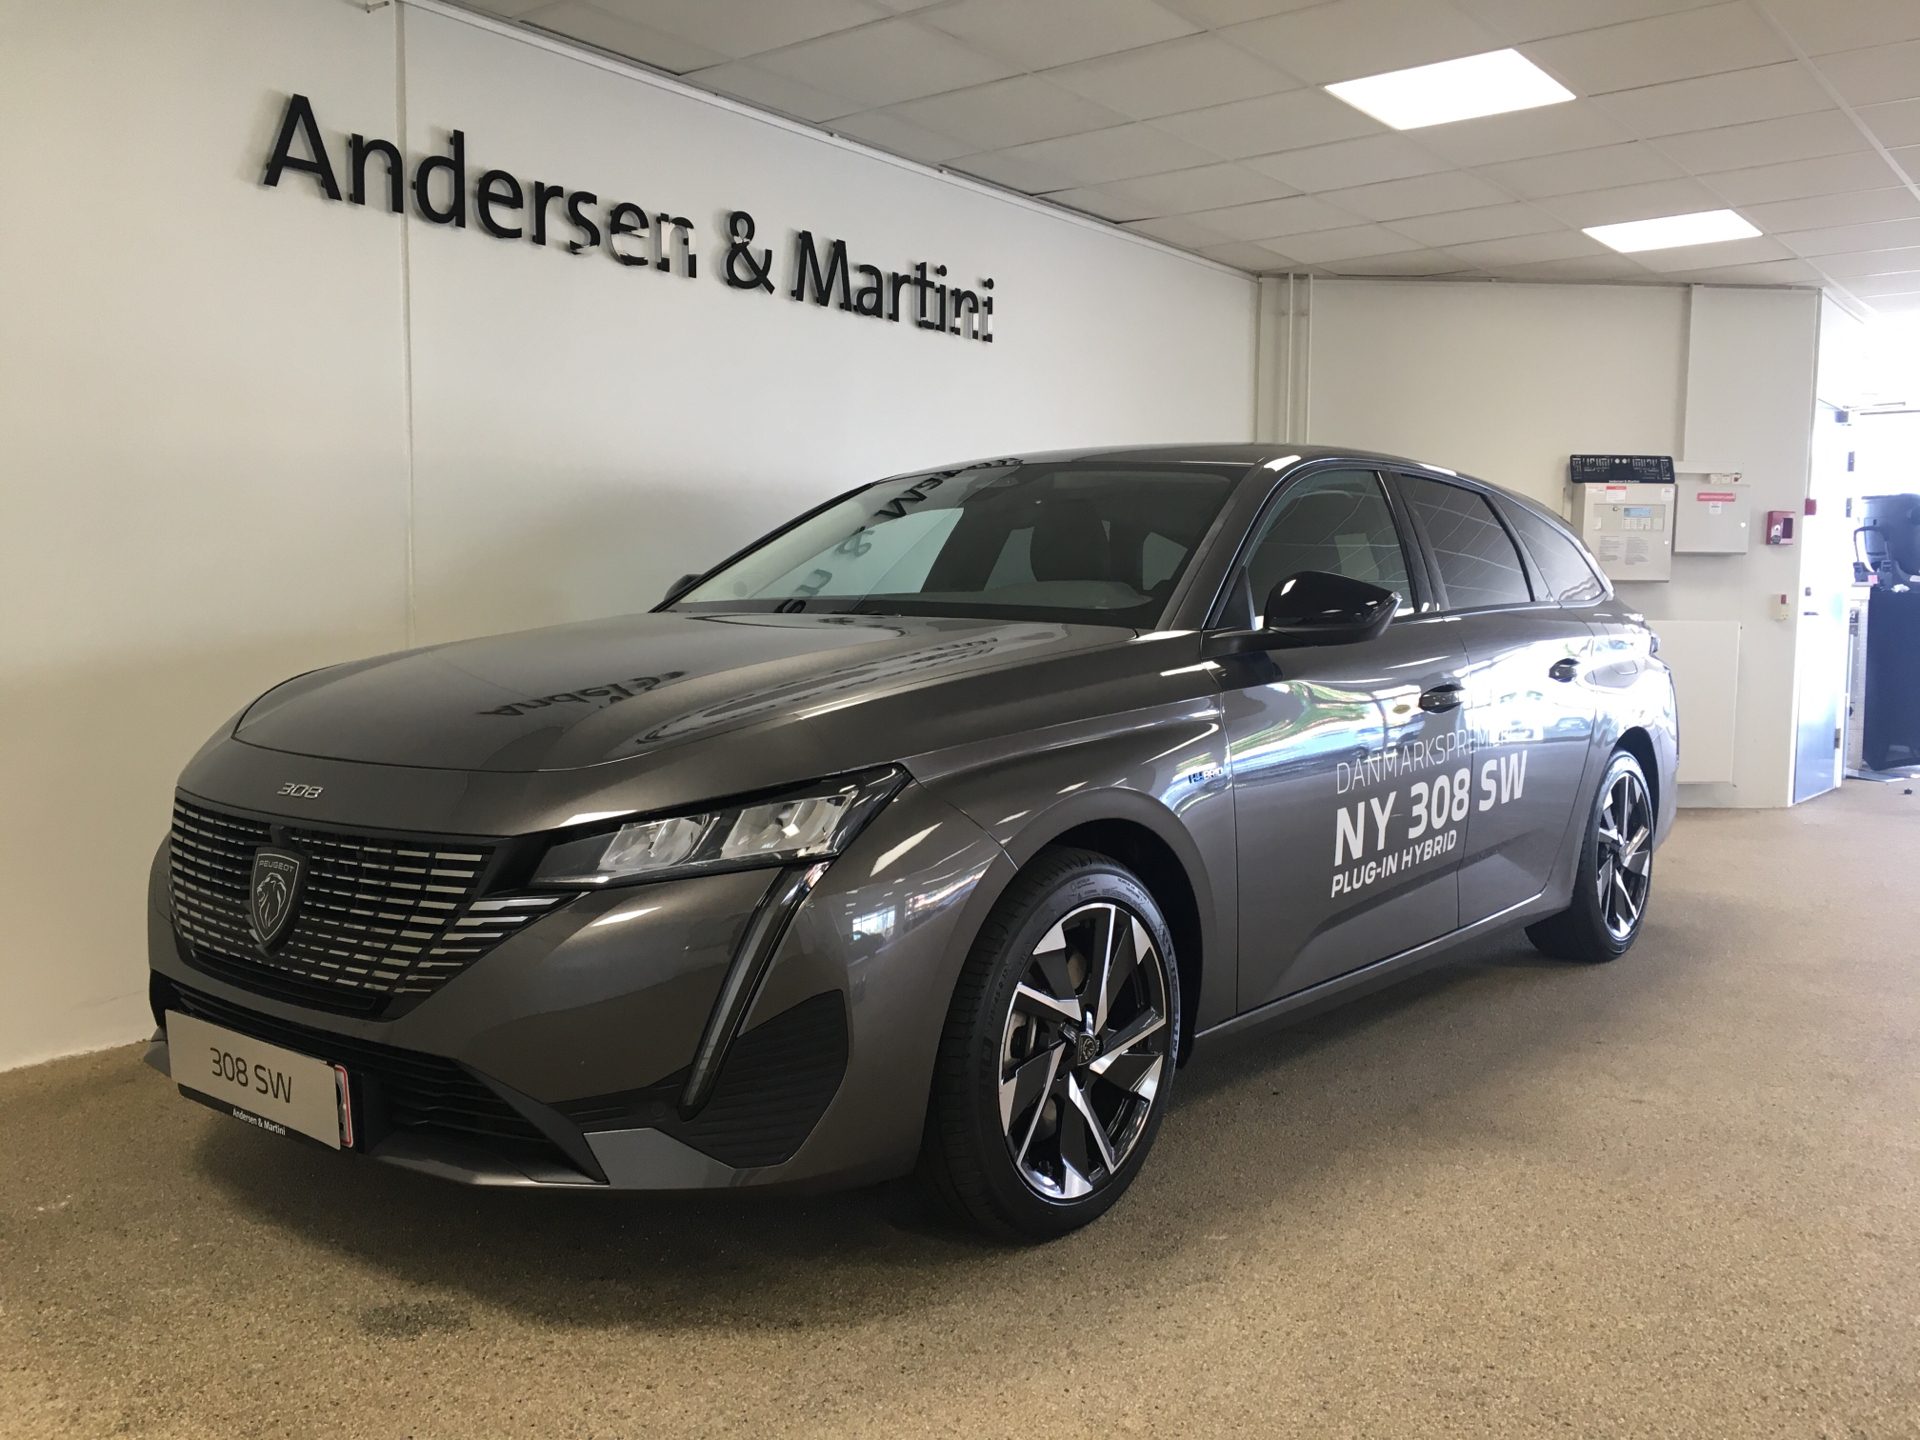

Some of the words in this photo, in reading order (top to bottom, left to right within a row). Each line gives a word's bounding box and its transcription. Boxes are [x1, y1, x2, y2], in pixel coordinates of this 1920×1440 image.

[263, 94, 698, 279] Andersen
[725, 210, 775, 295] &
[791, 229, 994, 342] Martini
[277, 782, 323, 799] 308
[1336, 722, 1516, 795] DANMARKSPREM
[1333, 790, 1397, 867] NY
[1407, 767, 1471, 840] 308
[1478, 749, 1528, 812] SW
[258, 859, 295, 873] PEUGEOT
[1330, 852, 1399, 899] PLUG-IN
[1401, 829, 1457, 871] HYBRID
[209, 1046, 249, 1088] 308
[253, 1064, 292, 1104] SW
[232, 1108, 258, 1126] Andersen
[263, 1120, 286, 1136] Martini
